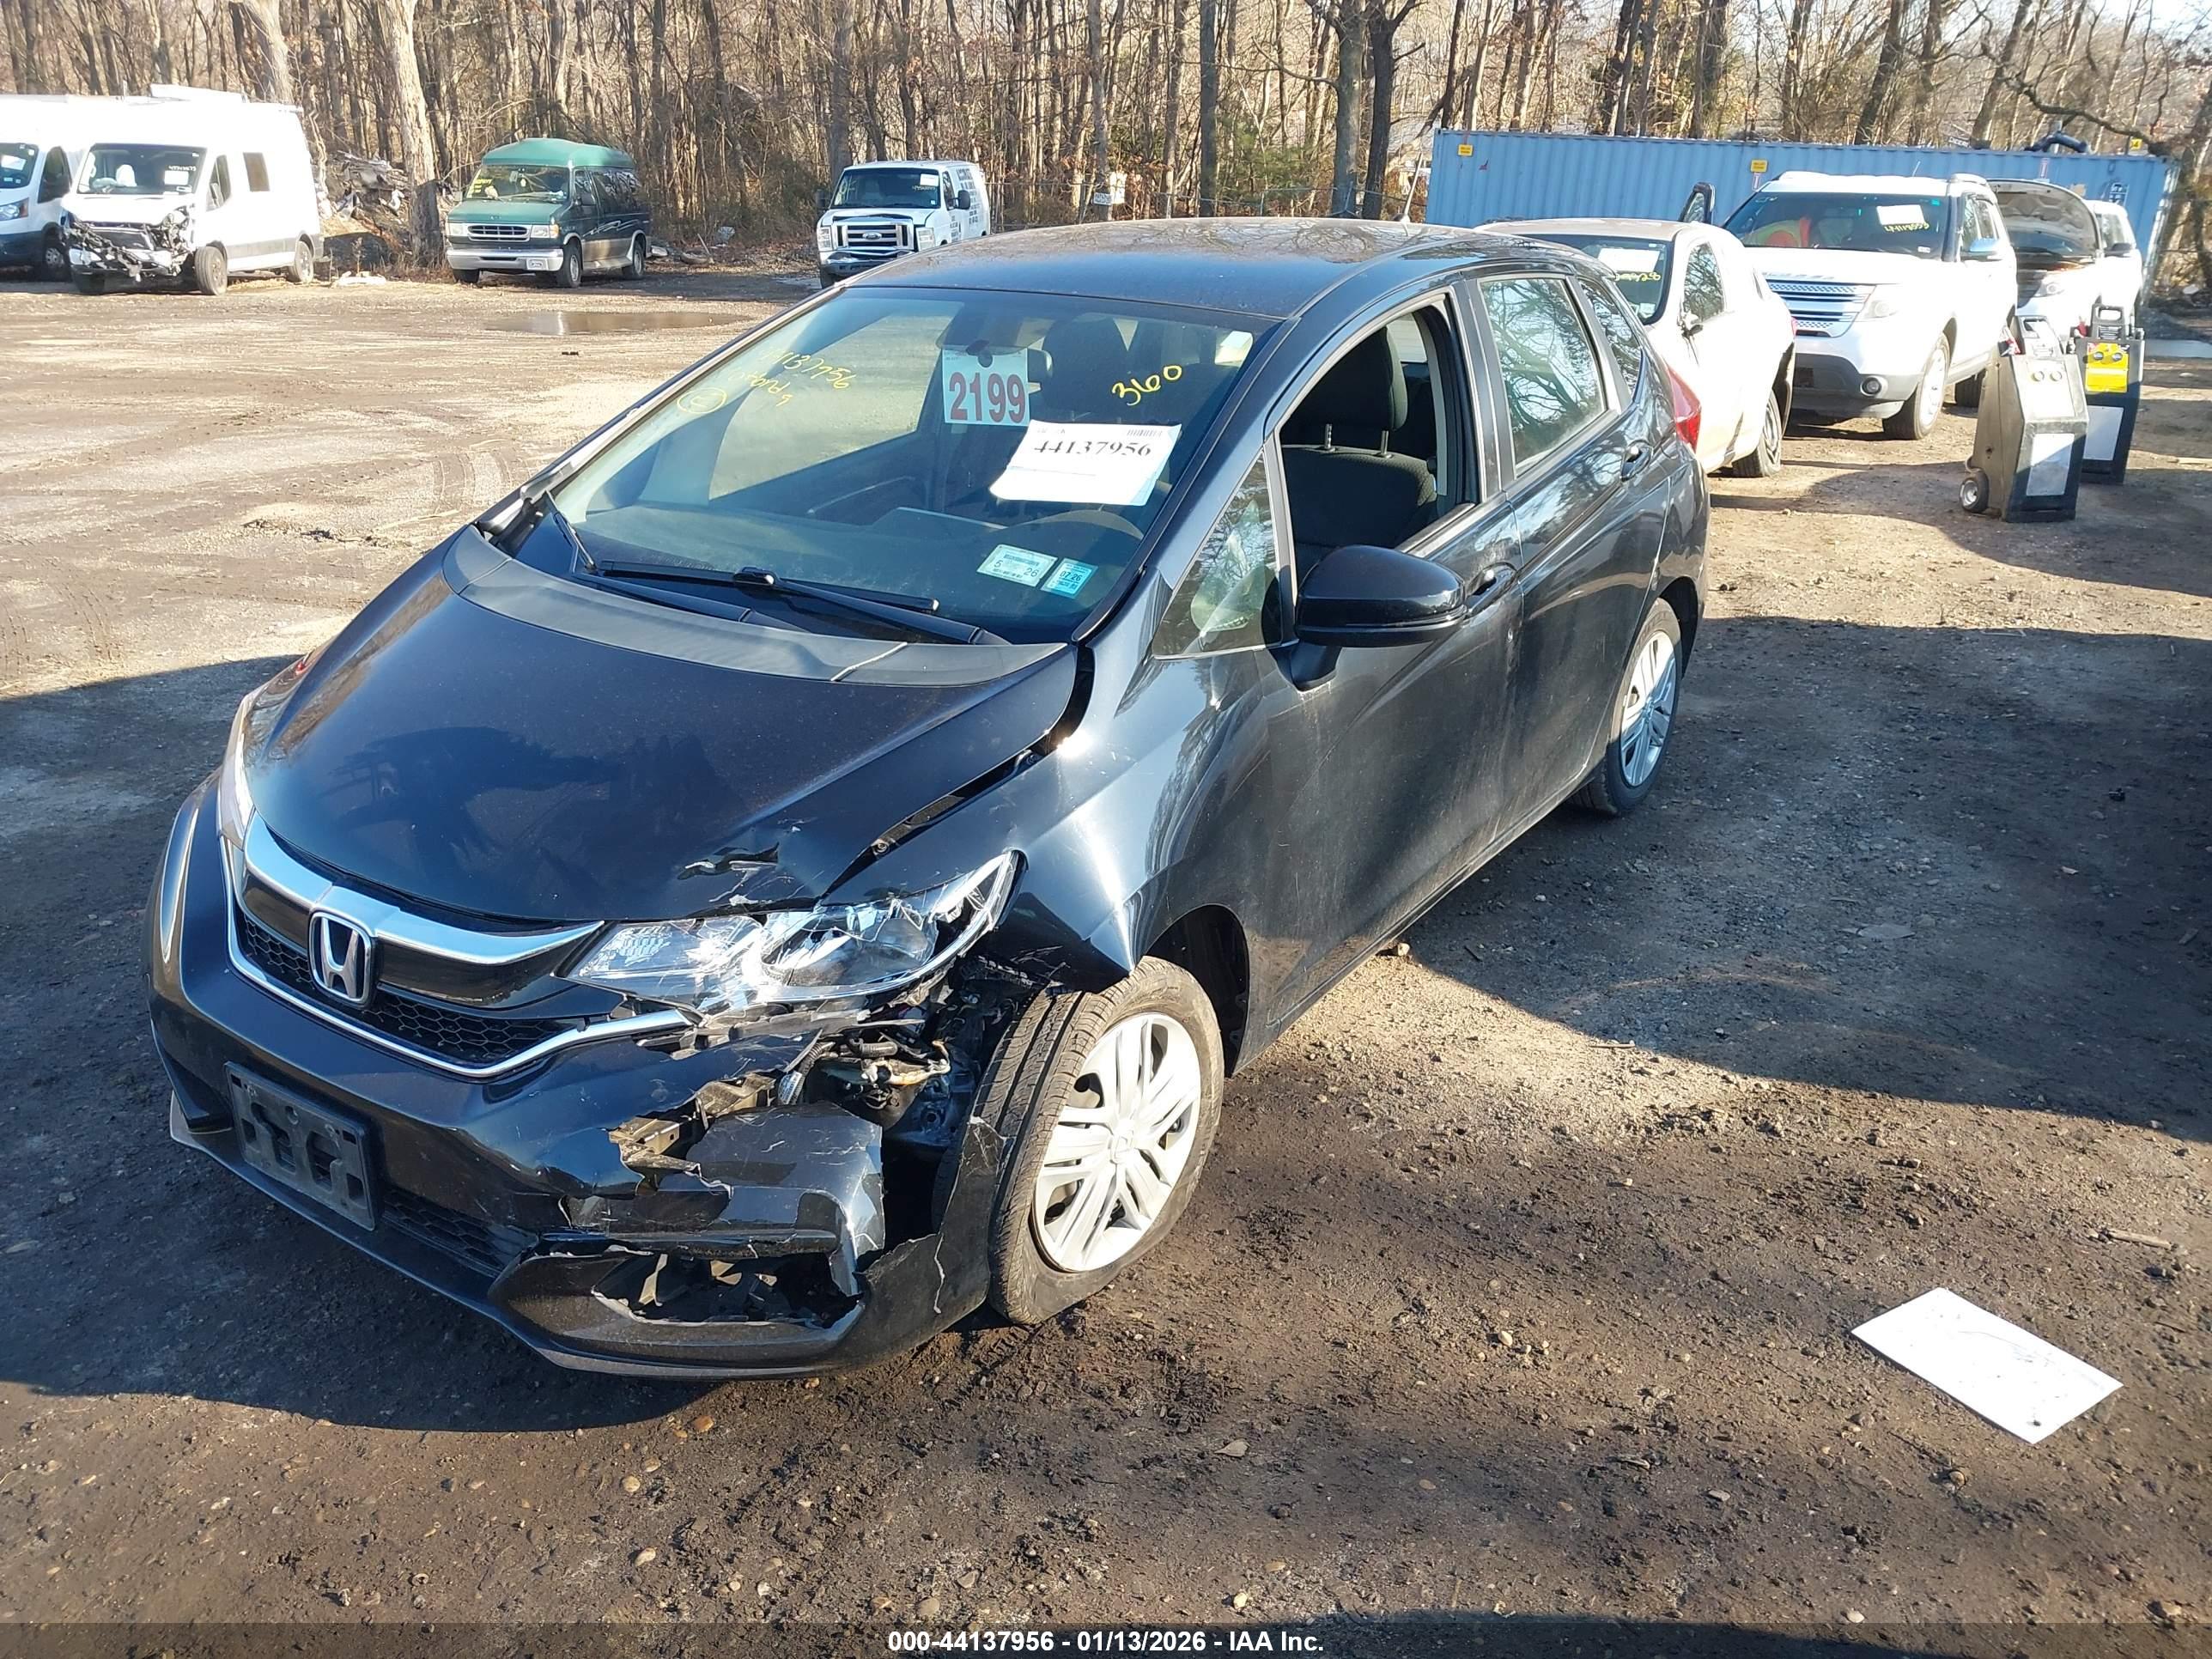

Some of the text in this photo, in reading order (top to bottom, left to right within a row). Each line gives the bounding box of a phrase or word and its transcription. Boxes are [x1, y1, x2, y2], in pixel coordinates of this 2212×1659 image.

[949, 371, 1026, 424] 2199
[1111, 364, 1182, 406] 360
[1034, 440, 1152, 457] 44137956
